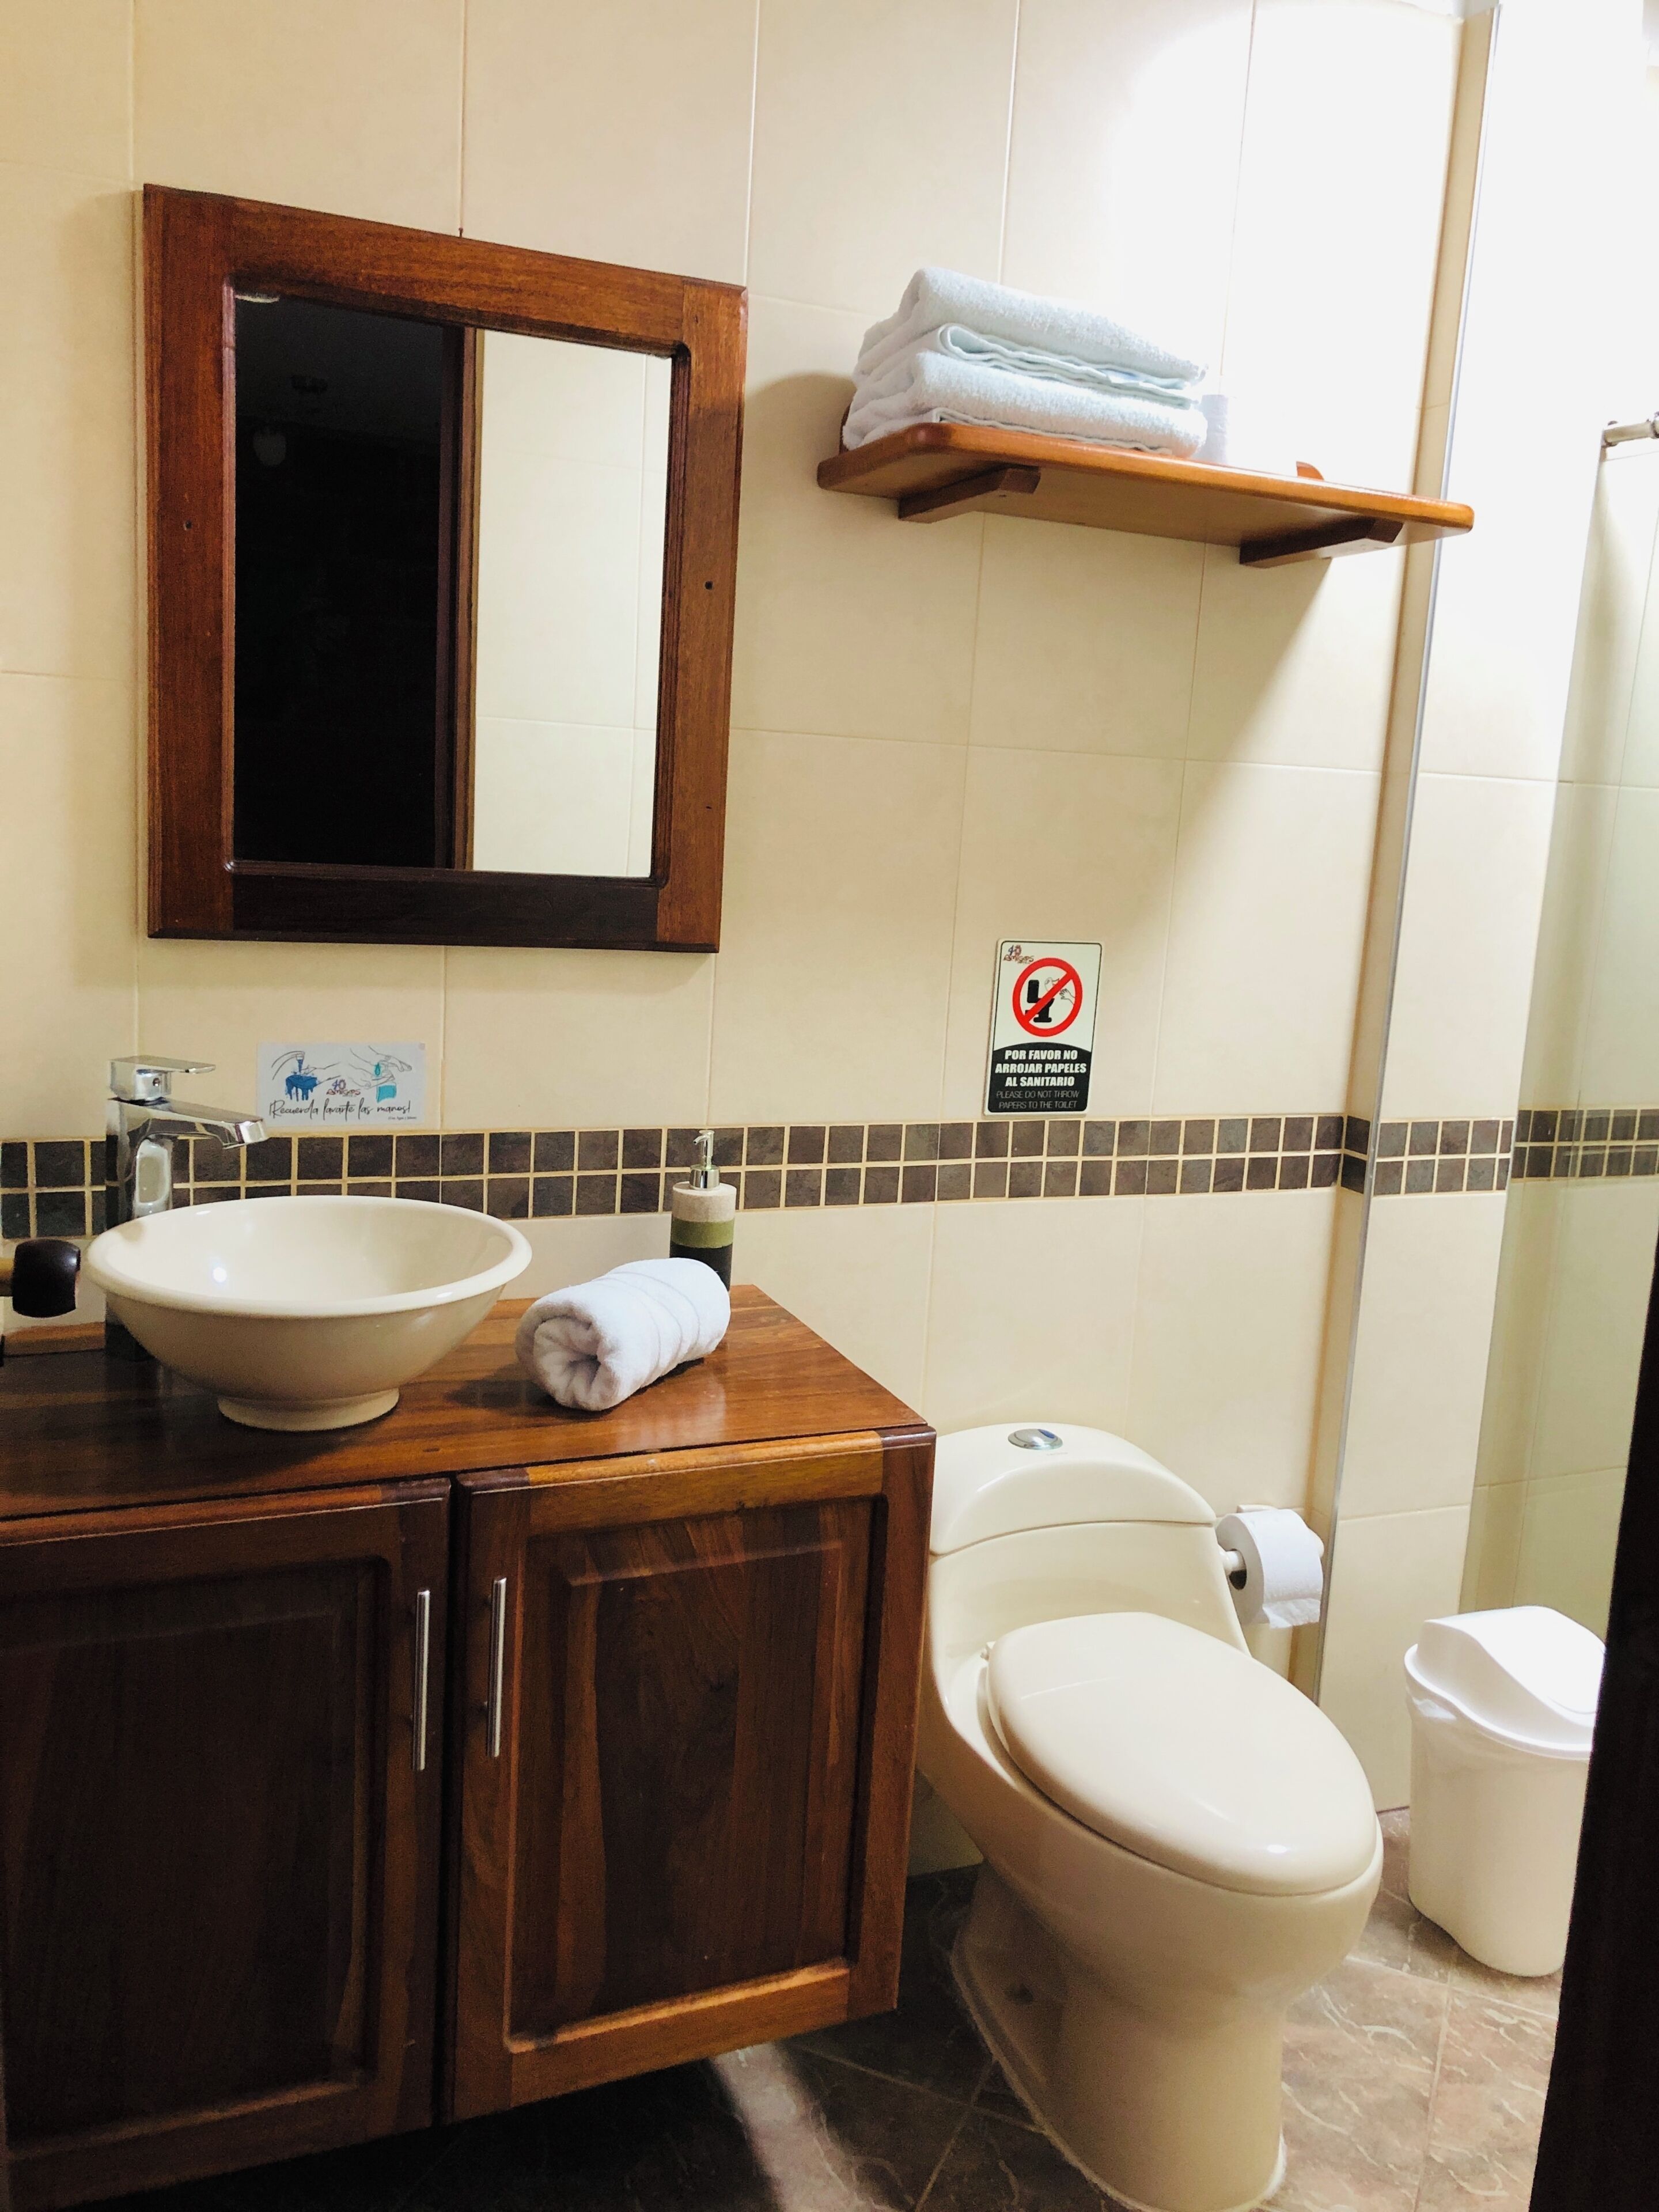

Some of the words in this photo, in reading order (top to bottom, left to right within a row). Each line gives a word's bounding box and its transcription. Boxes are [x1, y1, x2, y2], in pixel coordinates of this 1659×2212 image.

[1005, 1050, 1027, 1060] POR
[1028, 1050, 1061, 1060] FAVOR
[1063, 1050, 1078, 1060] NO
[995, 1063, 1043, 1073] ARROJAR
[1044, 1063, 1086, 1073] PAPELES
[1005, 1077, 1018, 1086] AL
[1020, 1076, 1075, 1086] SANITARIO
[996, 1090, 1023, 1099] PLEASE
[1025, 1090, 1036, 1099] DO
[323, 1098, 356, 1122] lavarte
[358, 1097, 373, 1120] las
